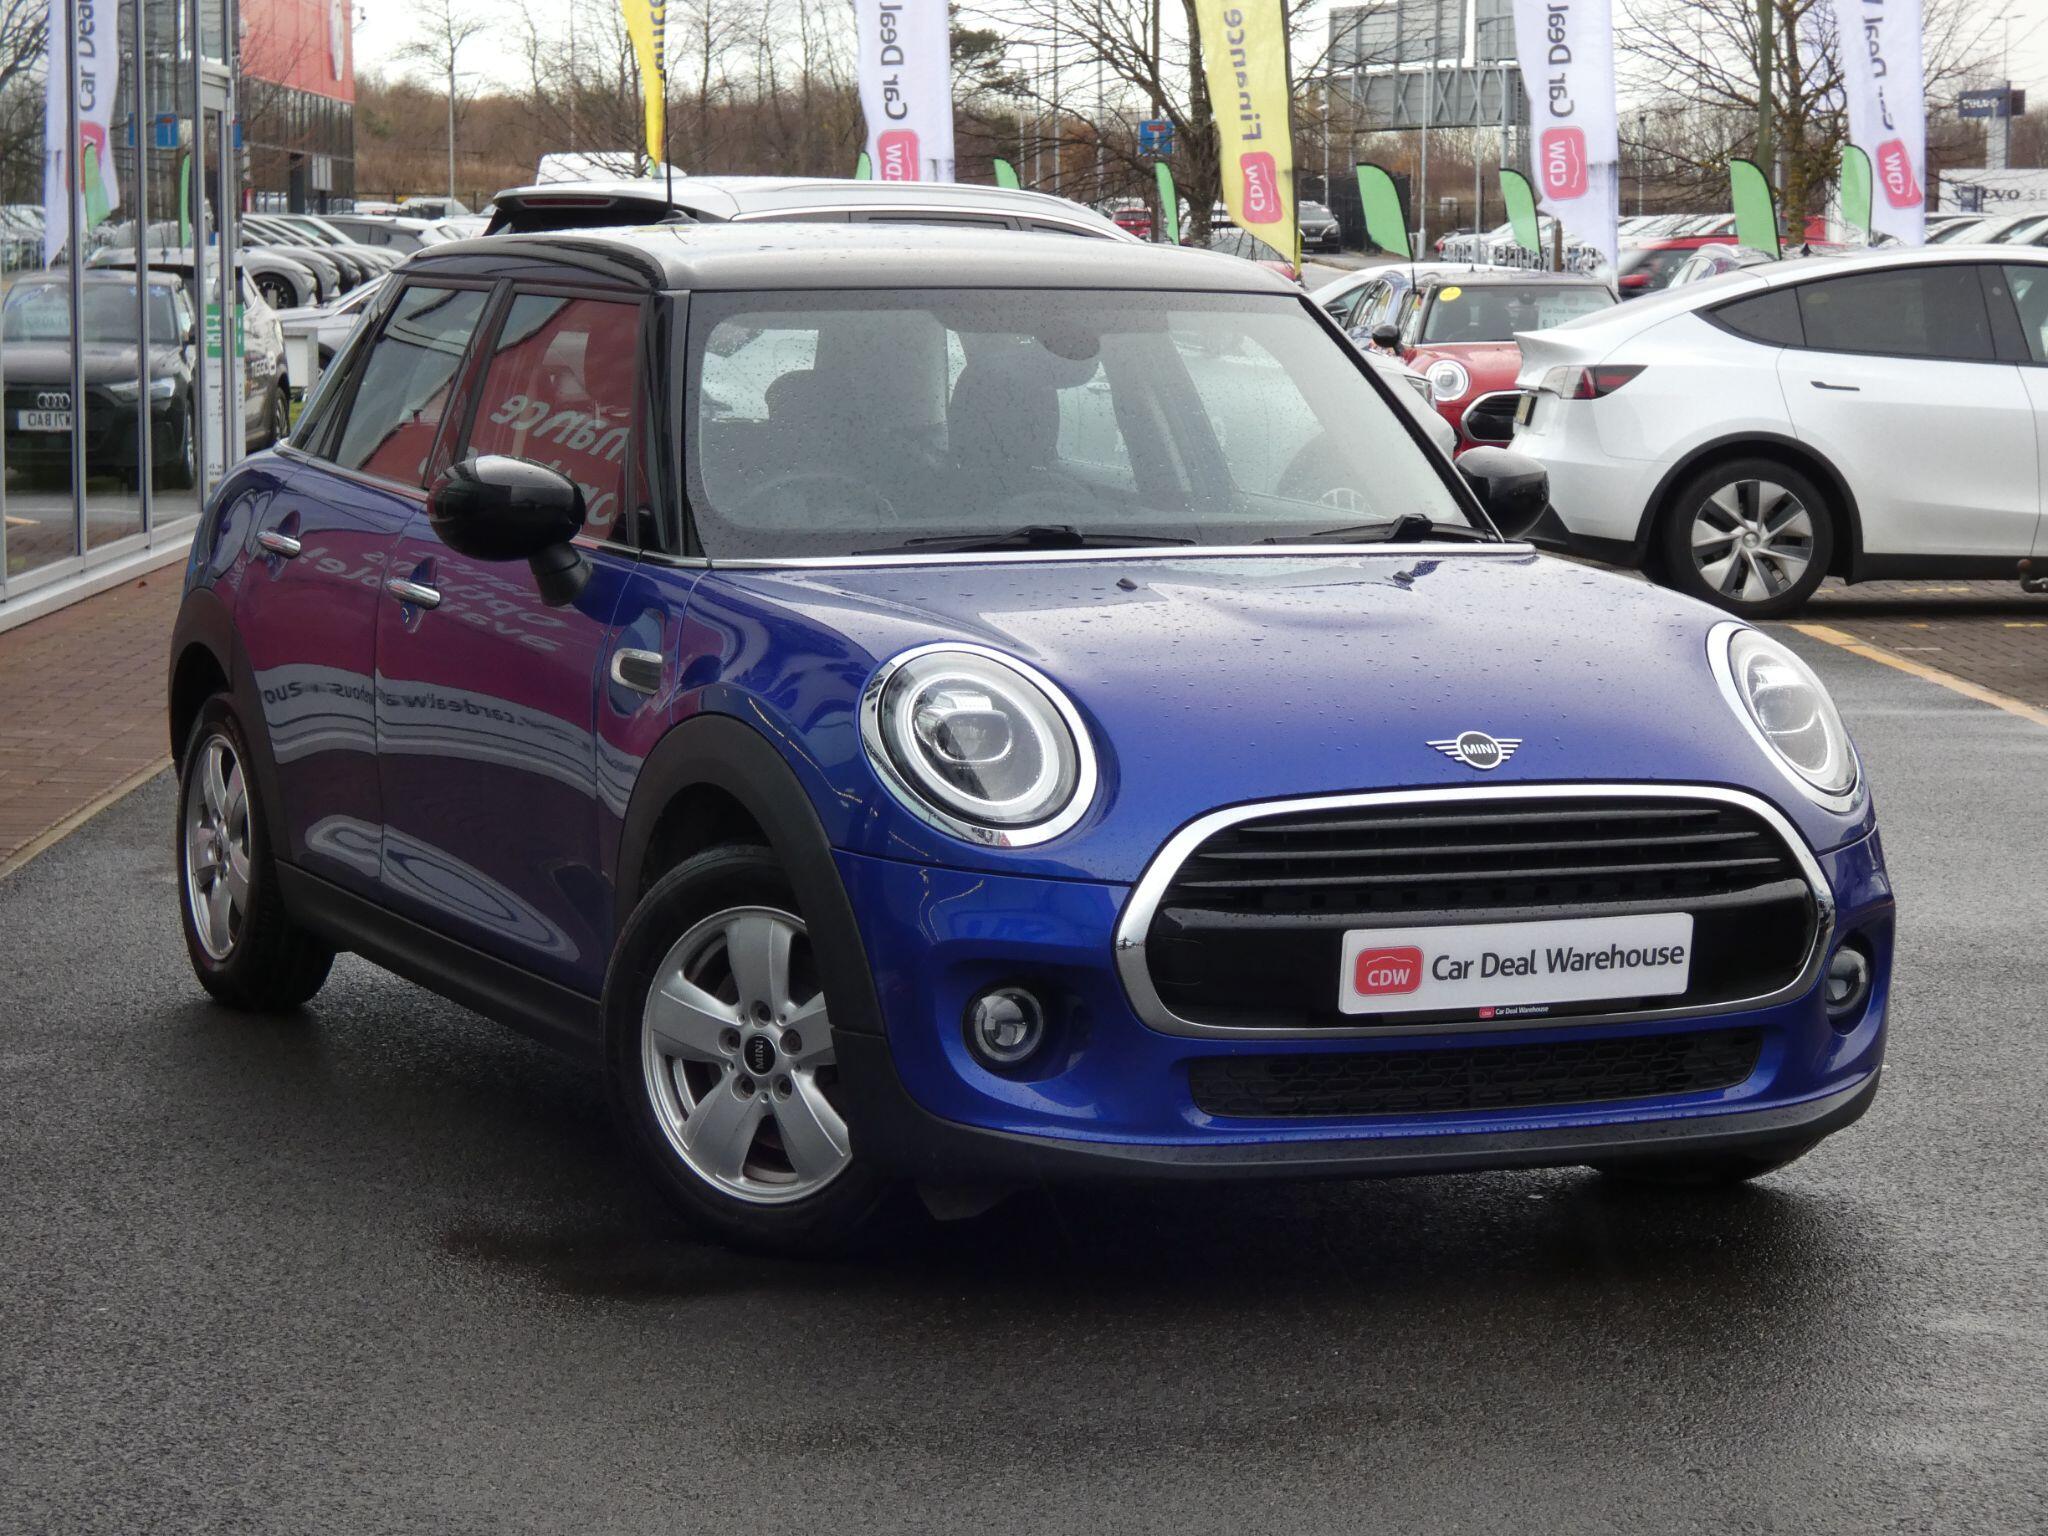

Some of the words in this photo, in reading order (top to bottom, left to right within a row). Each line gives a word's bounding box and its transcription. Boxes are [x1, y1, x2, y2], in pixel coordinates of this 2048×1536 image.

[79, 65, 96, 112] Car
[1953, 188, 2020, 201] VLVO
[1462, 743, 1497, 755] MINI
[1432, 954, 1475, 981] Car
[1480, 949, 1537, 979] Deal
[1546, 944, 1685, 974] Warehouse
[1367, 967, 1411, 987] CDW
